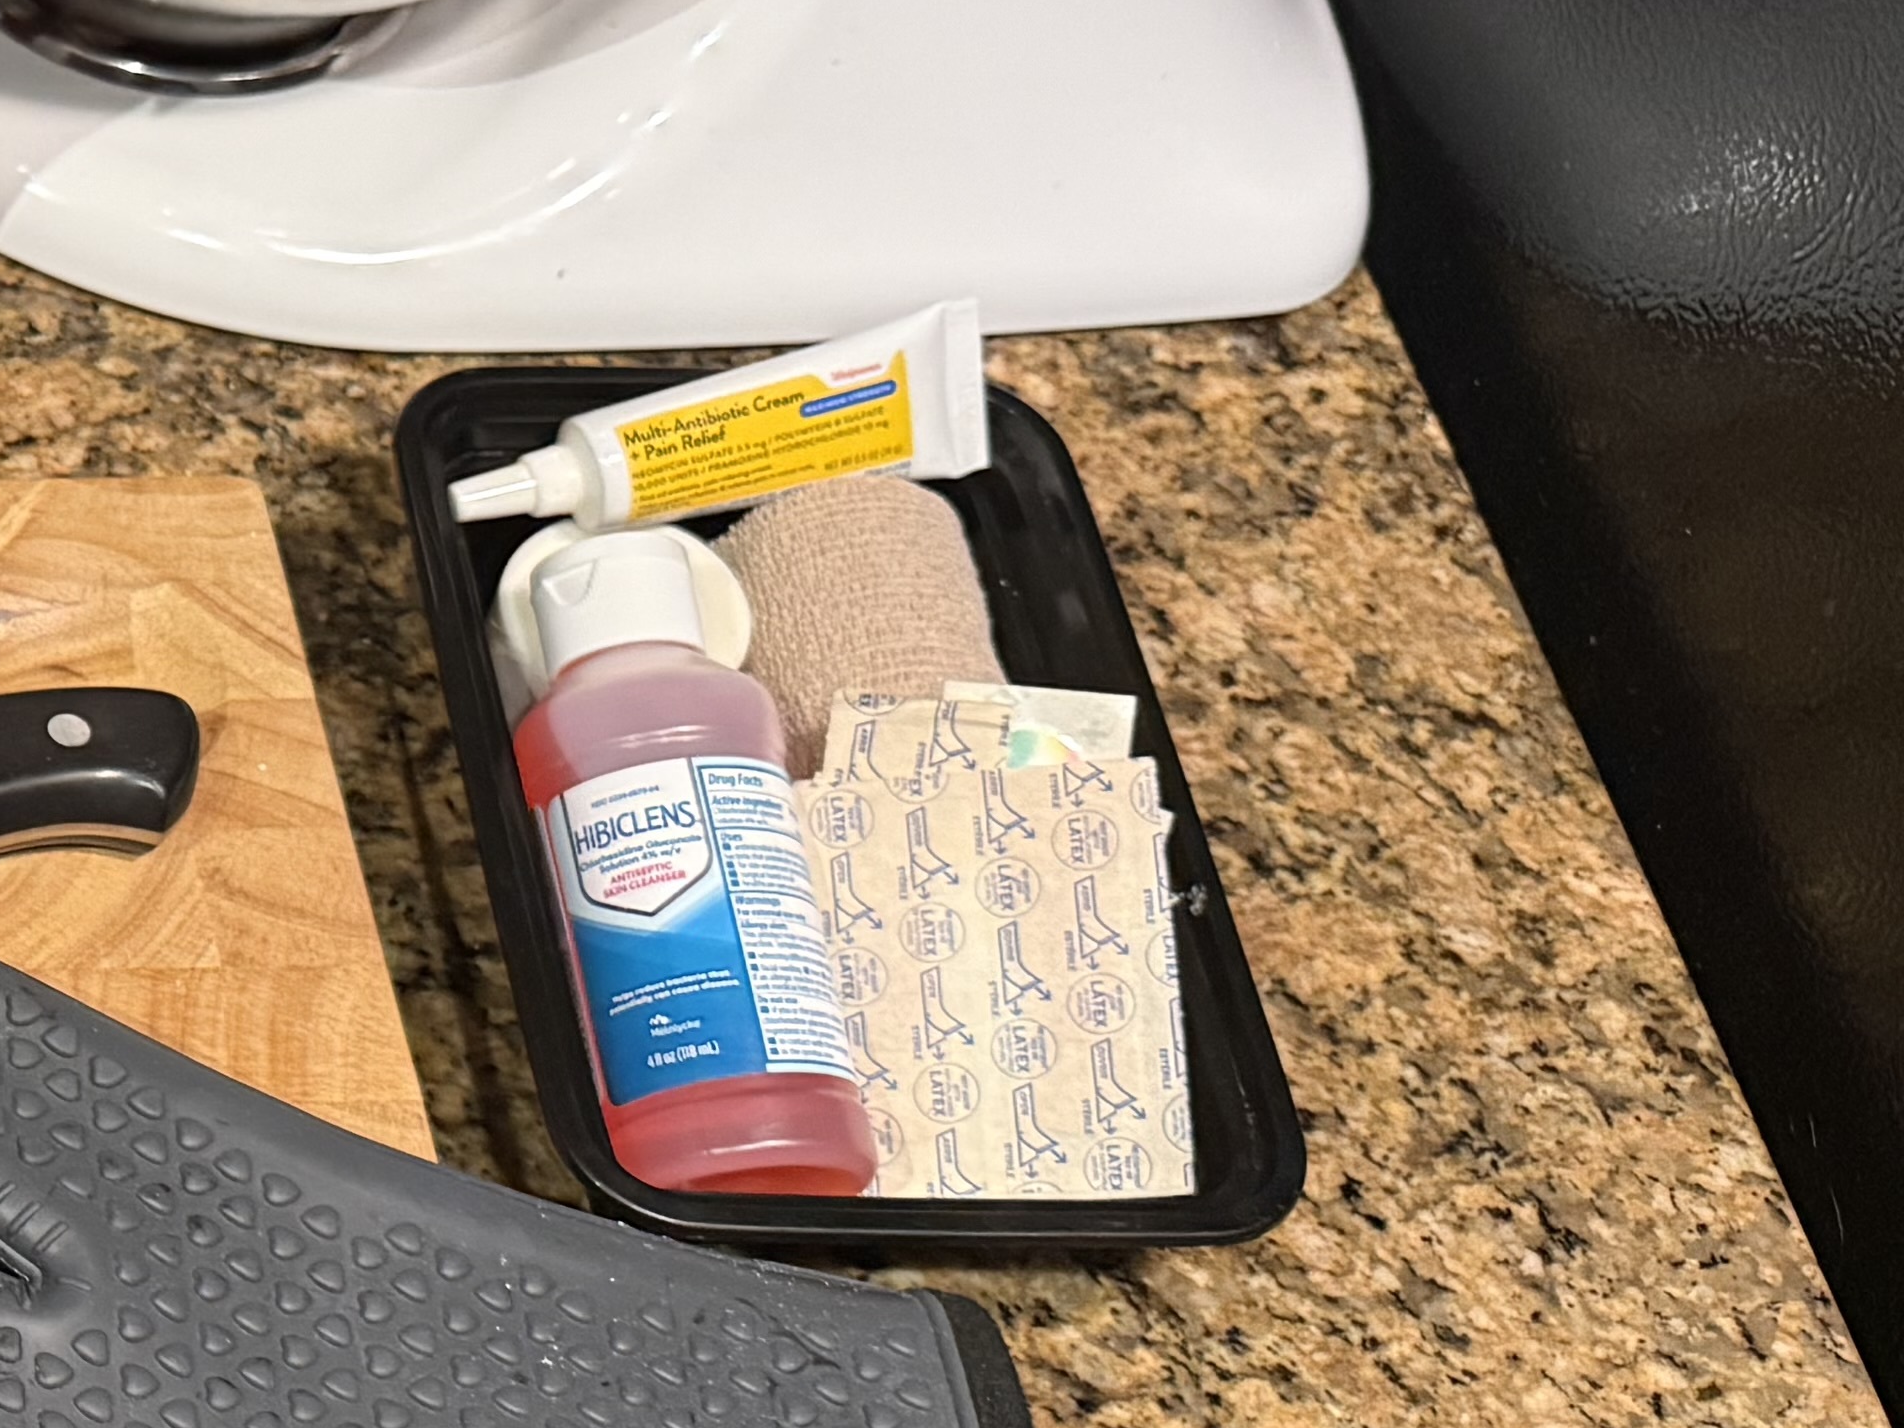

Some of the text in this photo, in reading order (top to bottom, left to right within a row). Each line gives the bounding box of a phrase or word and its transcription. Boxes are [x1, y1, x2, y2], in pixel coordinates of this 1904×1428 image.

[623, 390, 805, 448] Multi-Antibiotic Cream
[644, 441, 678, 461] Pain
[682, 424, 727, 451] Relief
[708, 773, 763, 788] Drug Facts
[574, 800, 696, 855] HIBICLENS
[1068, 817, 1084, 864] LATEX
[603, 870, 687, 899] SKIN CLEANSER
[610, 861, 673, 885] ANTISEPTIC
